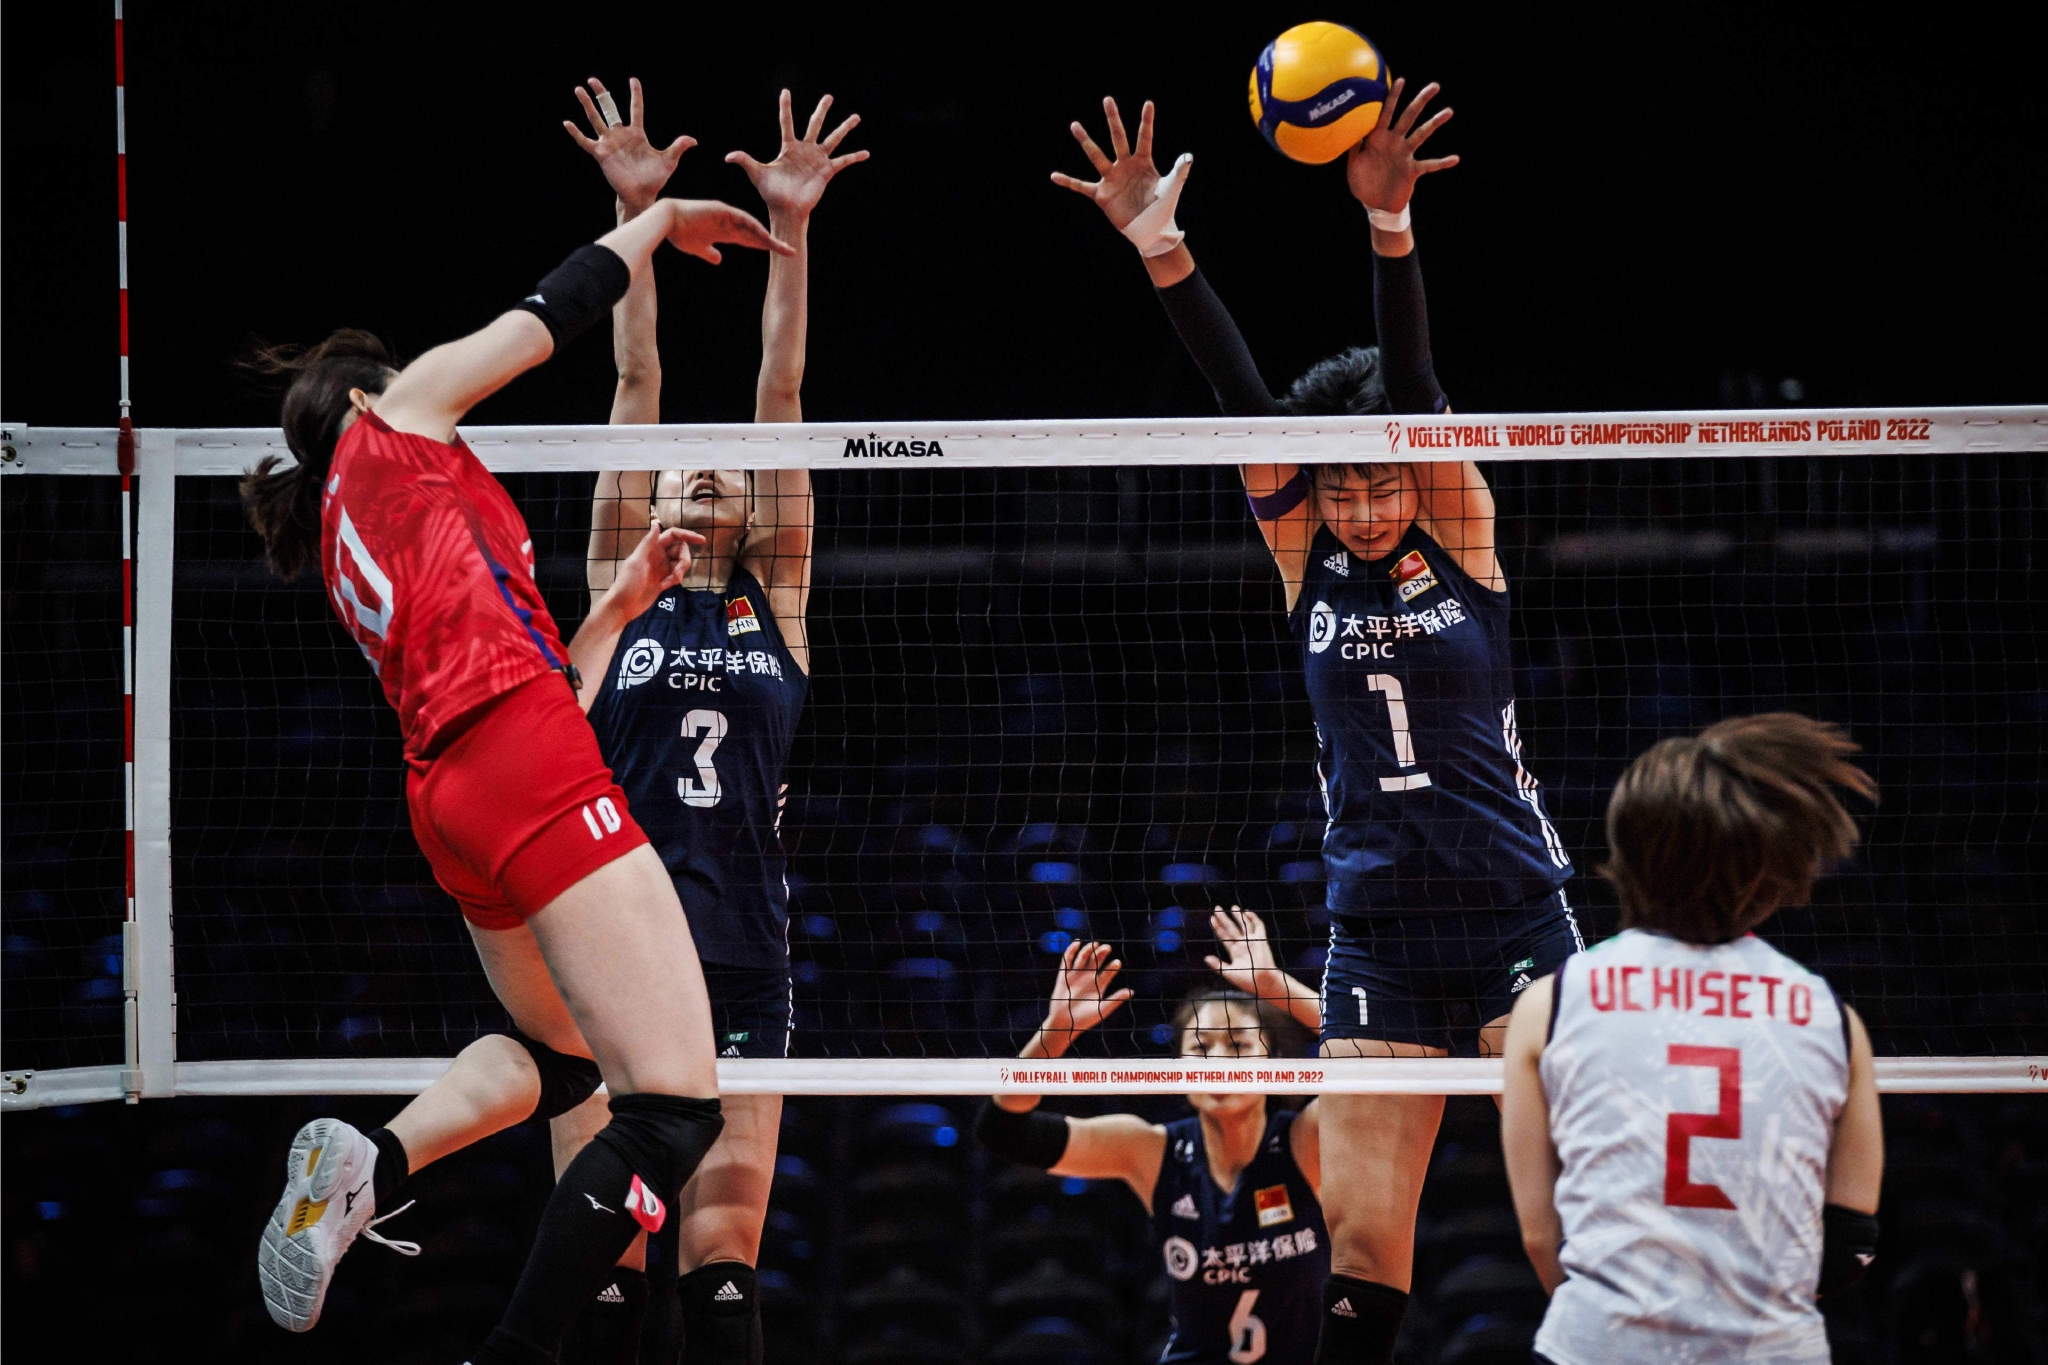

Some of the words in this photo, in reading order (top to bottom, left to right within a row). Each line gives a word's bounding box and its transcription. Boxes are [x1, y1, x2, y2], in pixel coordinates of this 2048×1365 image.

[1407, 424, 1499, 450] VOLLEYBALL
[1506, 424, 1565, 448] WORLD
[1571, 421, 1692, 447] CHAMPIONSHIP
[1699, 419, 1811, 445] NETHERLANDS
[1817, 418, 1881, 443] POLAND
[1887, 417, 1930, 442] 2022
[1402, 575, 1432, 596] CHN
[1340, 597, 1467, 640] 太平洋保险
[1340, 642, 1395, 660] CPIC
[668, 672, 722, 692] CPIC
[1366, 674, 1433, 791] 1
[677, 709, 729, 808] 3
[582, 796, 621, 841] 10
[1351, 987, 1369, 1026] 1
[1590, 966, 1812, 1025] UCHISETO
[1013, 1071, 1067, 1084] VOLLEYBALL
[1072, 1071, 1107, 1084] WORLD
[1111, 1071, 1183, 1084] CHAMPIONSHIP
[1186, 1070, 1253, 1083] NETHERLANDS
[1257, 1070, 1295, 1083] POLAND
[1299, 1070, 1324, 1083] 2022
[1664, 1045, 1742, 1210] 2
[1201, 1227, 1319, 1269] 太平洋保险
[1203, 1267, 1252, 1285] CPIC
[597, 1293, 625, 1304] adidas
[714, 1291, 743, 1302] adidas
[1331, 1305, 1358, 1318] adidas
[1229, 1290, 1268, 1365] 6
